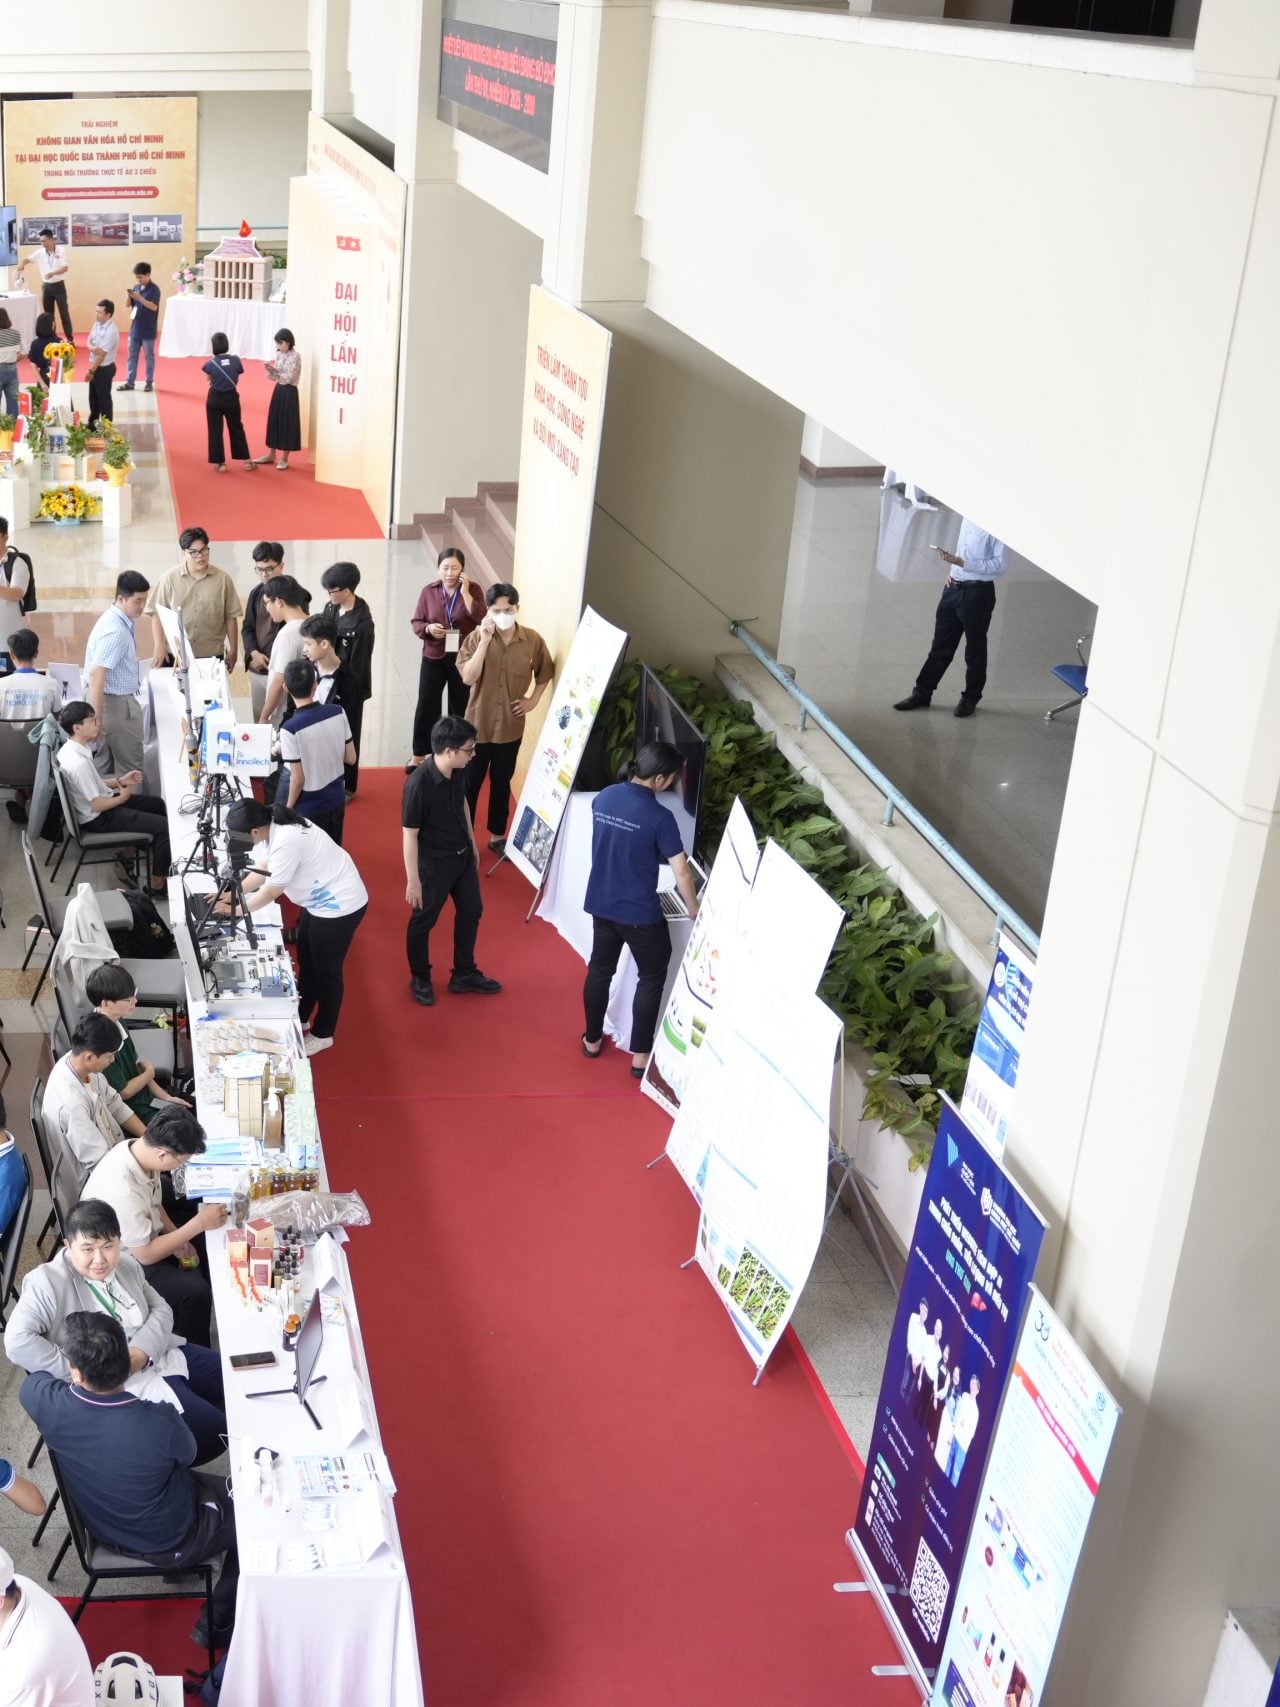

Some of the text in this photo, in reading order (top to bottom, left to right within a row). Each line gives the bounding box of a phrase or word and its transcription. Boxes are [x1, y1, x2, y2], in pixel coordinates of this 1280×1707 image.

[36, 133, 164, 146] KHÔNG GIAN VĂN HÓA HỒ CHÍ MINH
[15, 149, 186, 164] TẠI ĐẠI HỌC QUỐC GIA THÀNH PHỐ HỒ CHÍ MINH
[335, 281, 357, 305] ĐẠI
[334, 311, 356, 336] HỘI
[330, 339, 357, 364] LẦN
[330, 374, 357, 396] THỨ
[339, 407, 344, 424] I
[236, 757, 270, 766] InnoTech
